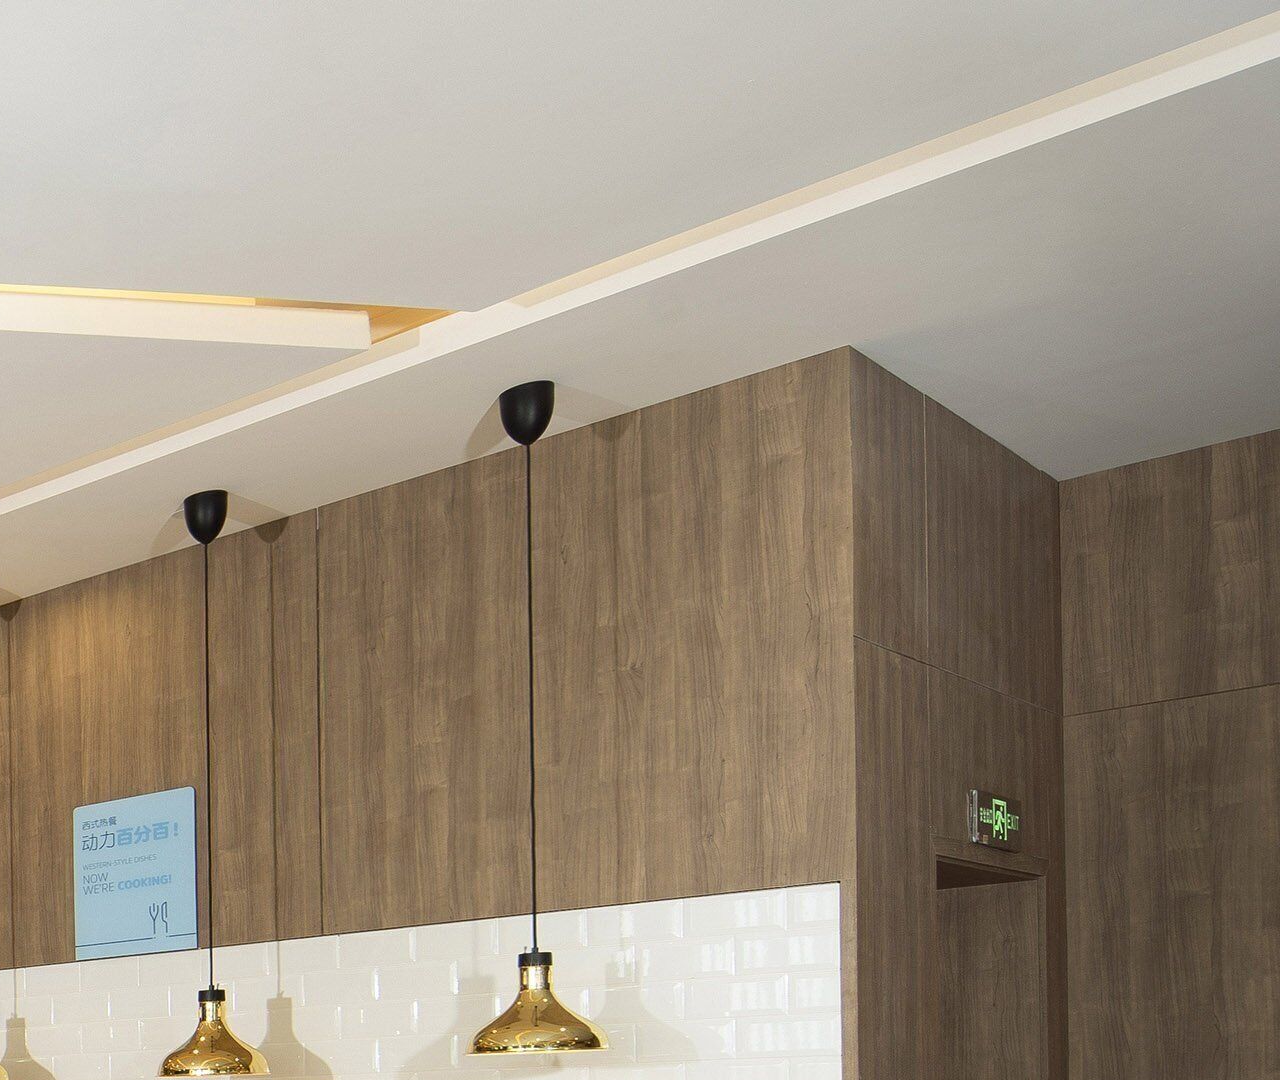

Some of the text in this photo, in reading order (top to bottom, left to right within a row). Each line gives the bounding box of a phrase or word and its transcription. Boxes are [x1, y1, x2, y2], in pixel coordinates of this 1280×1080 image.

[82, 872, 109, 885] NOW
[82, 873, 172, 895] WE'RE COOKING!
